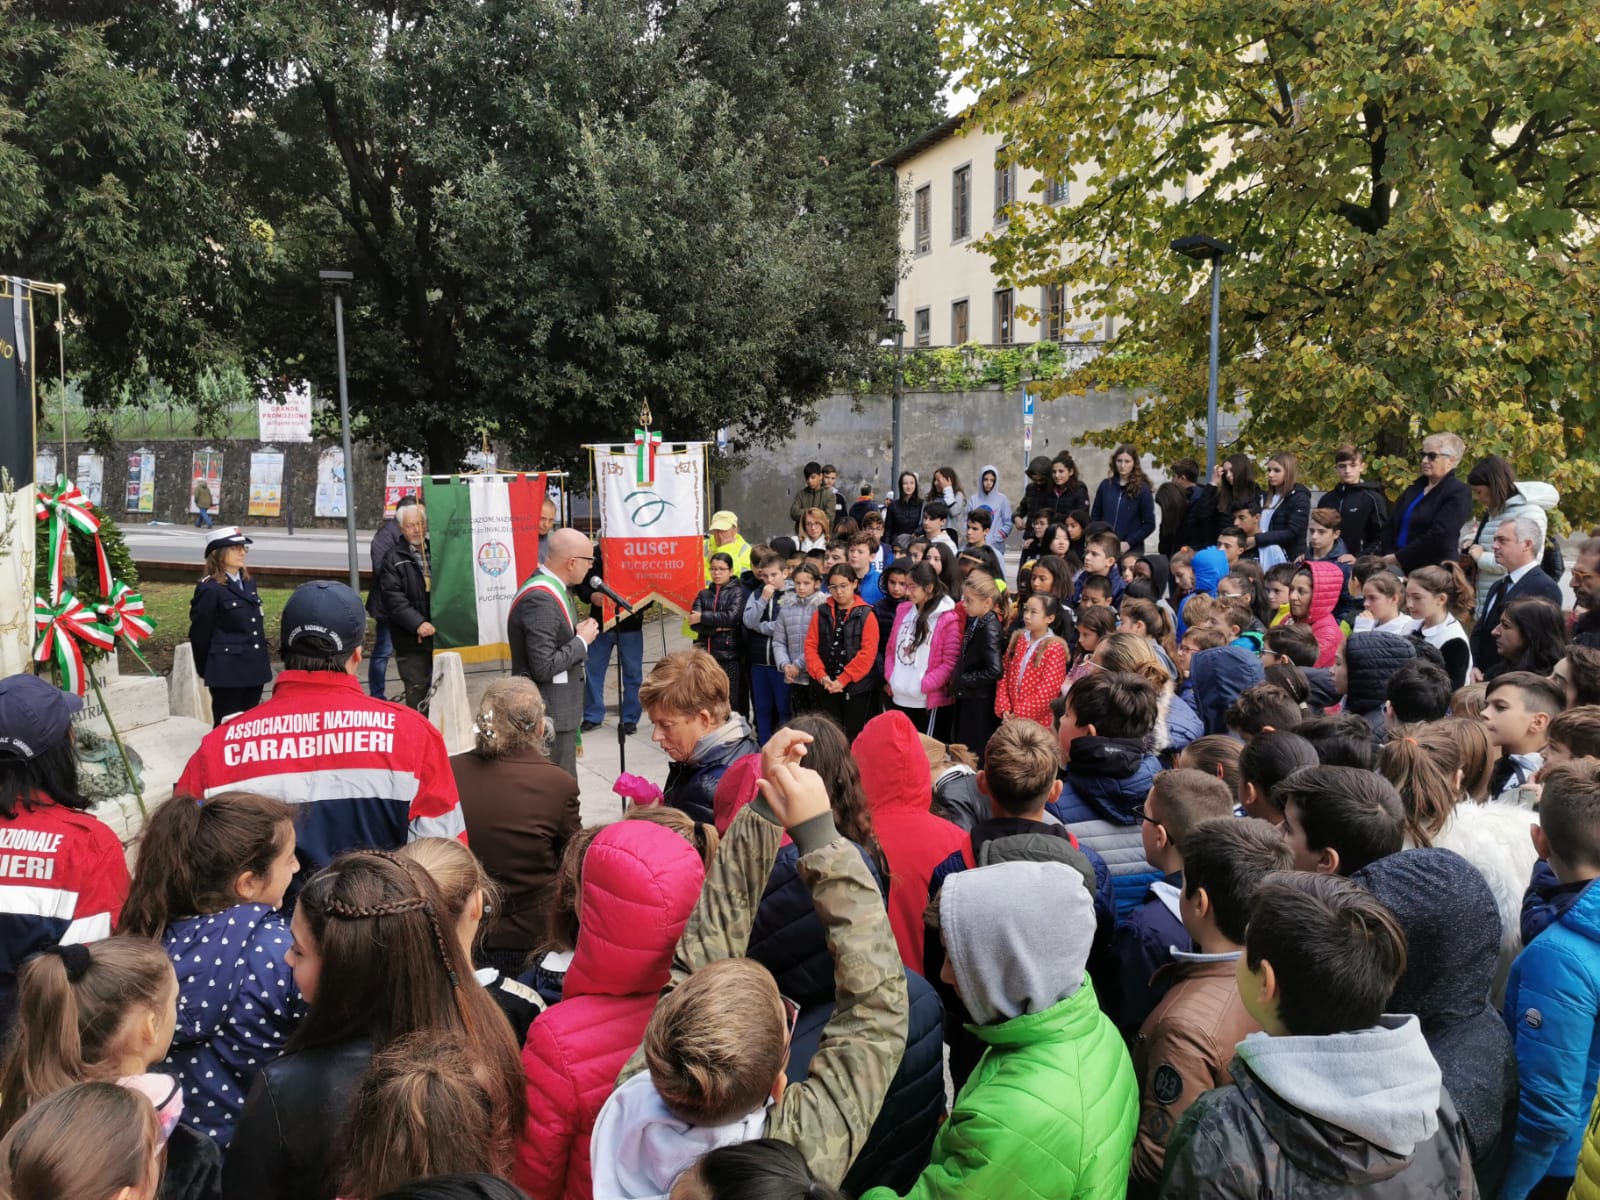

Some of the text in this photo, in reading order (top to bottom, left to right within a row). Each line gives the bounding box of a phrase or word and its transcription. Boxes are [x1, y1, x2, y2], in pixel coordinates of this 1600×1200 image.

[623, 540, 679, 556] auser
[621, 560, 684, 570] FUCECCHIO
[224, 710, 396, 741] ASSOCIAZIONE NAZIONALE
[223, 731, 394, 767] CARABINIERI
[0, 827, 64, 853] AZIONALE
[0, 854, 55, 880] IERI
